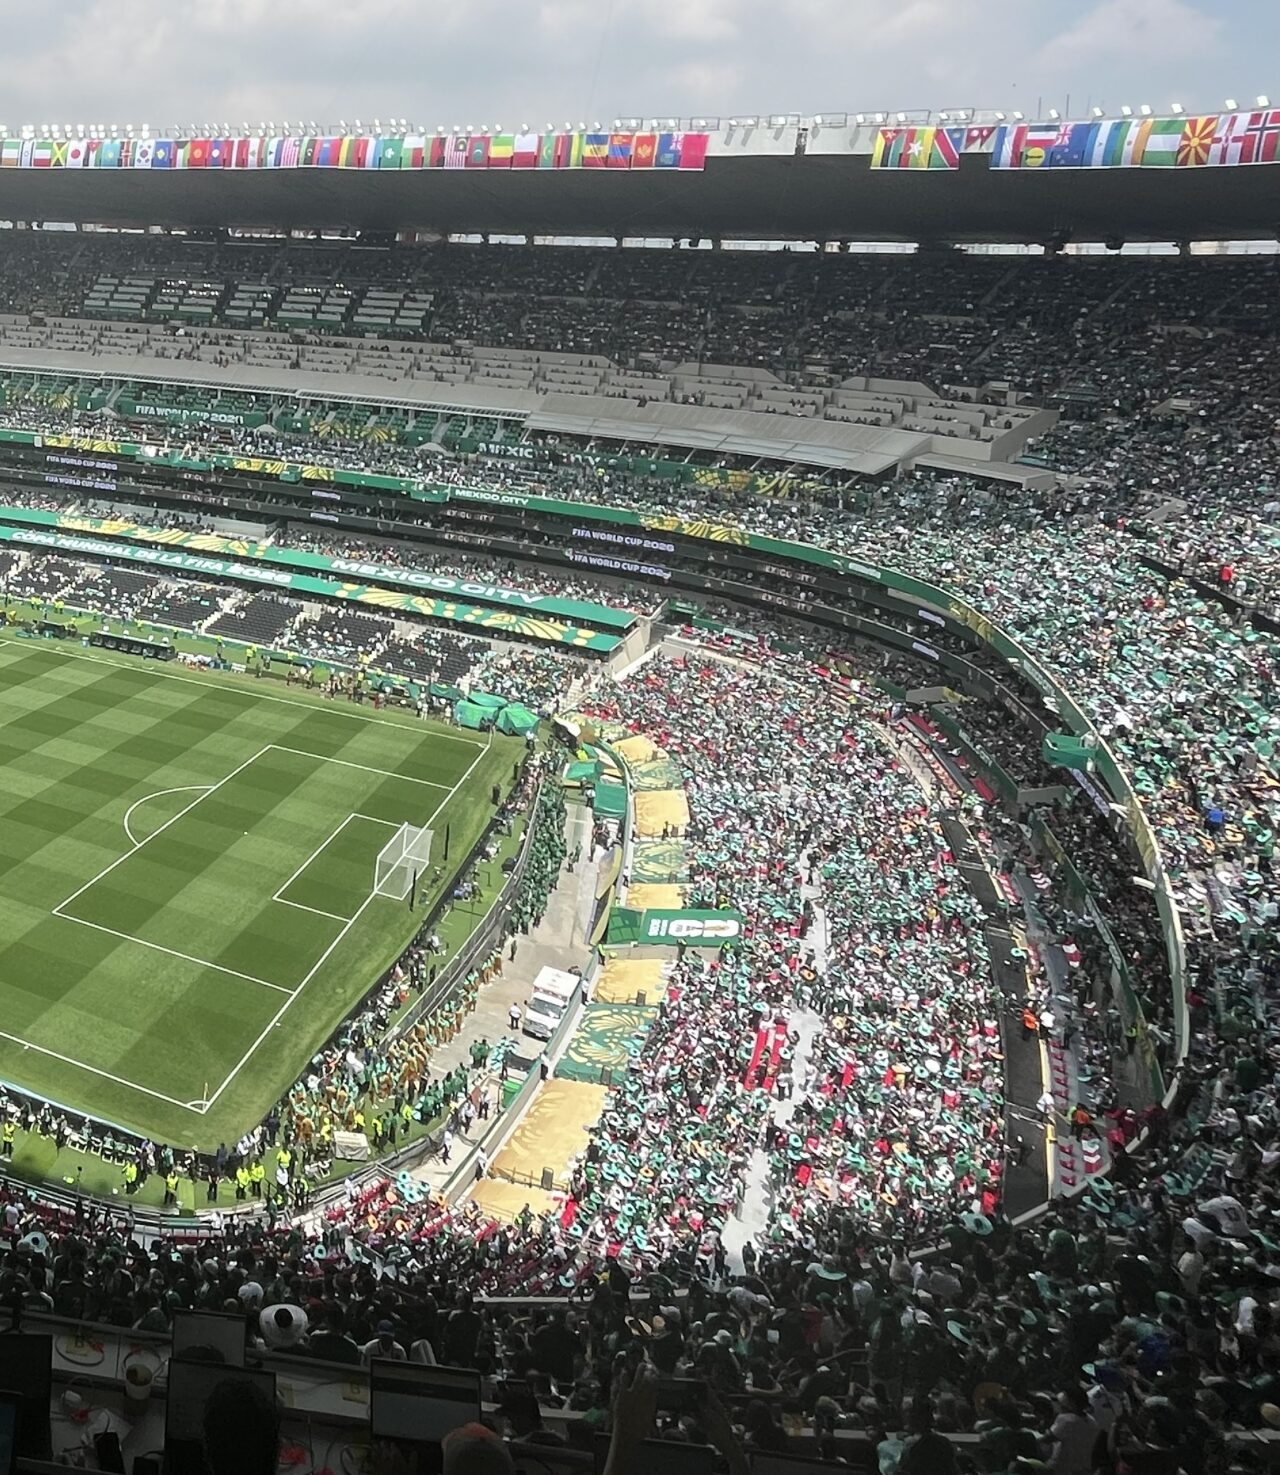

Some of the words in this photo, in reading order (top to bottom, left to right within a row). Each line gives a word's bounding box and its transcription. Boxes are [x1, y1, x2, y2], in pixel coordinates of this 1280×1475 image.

[135, 405, 155, 415] FIFA
[60, 457, 82, 465] WORLD
[455, 489, 499, 501] MEXICO
[501, 495, 529, 505] CITY
[572, 528, 591, 538] FIFA
[592, 531, 623, 543] WORLD
[624, 536, 643, 546] CUP
[643, 539, 675, 552] 2026
[11, 530, 55, 545] COPA
[56, 538, 132, 556] MUNDIAL
[134, 549, 159, 560] DE
[159, 553, 182, 564] LA
[184, 557, 224, 571] FIFA
[225, 563, 293, 583] 2026
[589, 557, 621, 569] WORLD
[621, 562, 640, 572] CUP
[640, 566, 671, 579] 202
[331, 559, 456, 589] MEXICO
[459, 583, 545, 604] CITY
